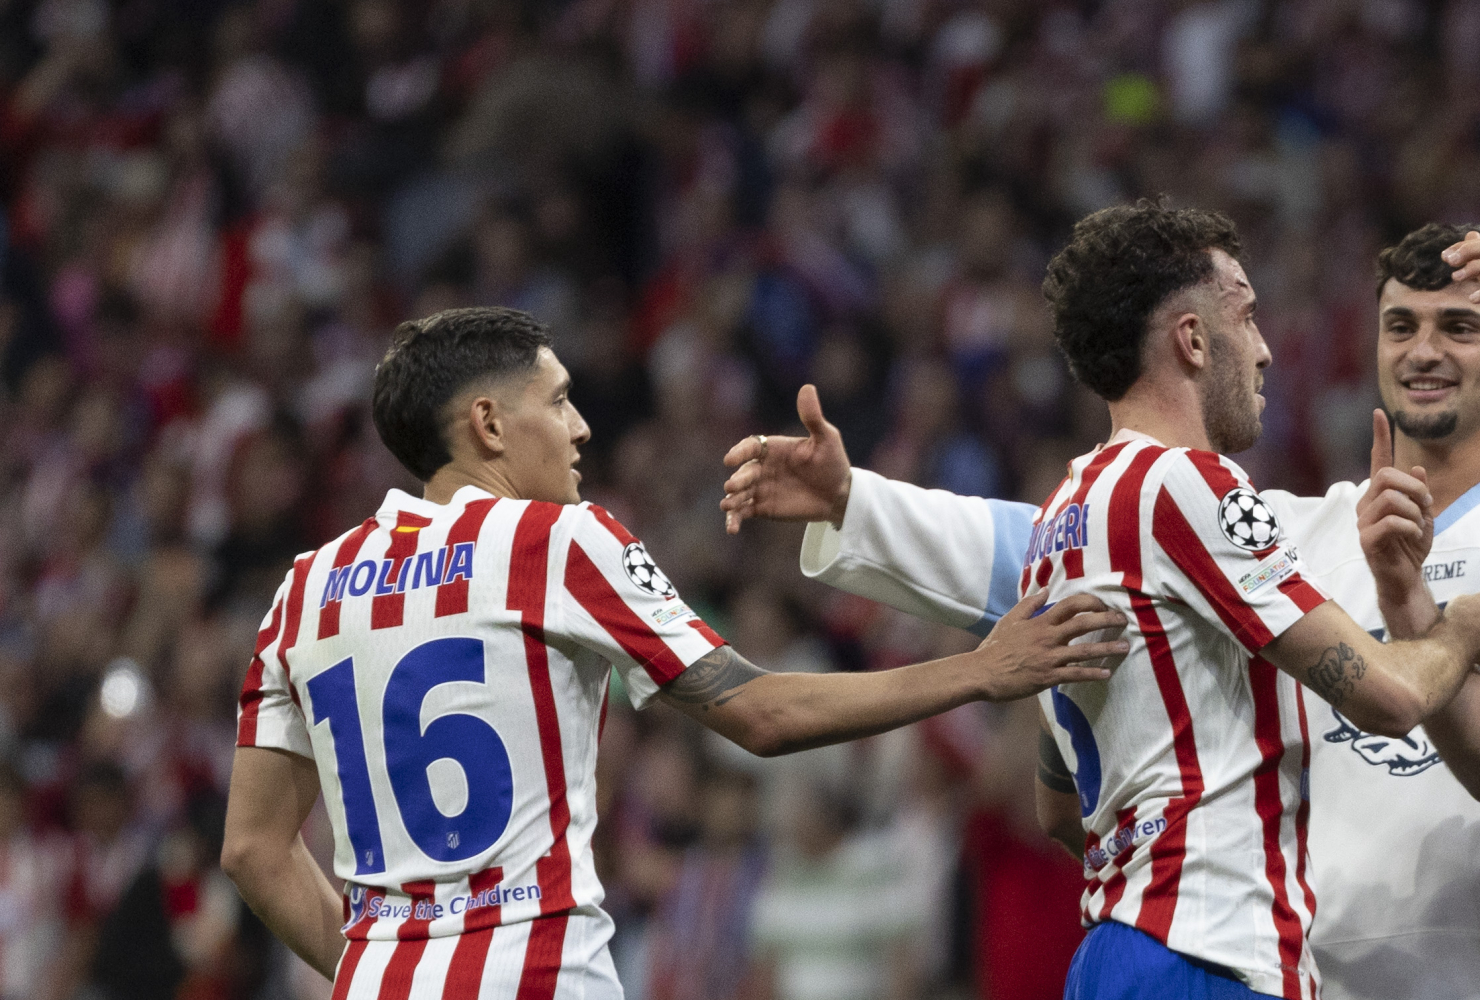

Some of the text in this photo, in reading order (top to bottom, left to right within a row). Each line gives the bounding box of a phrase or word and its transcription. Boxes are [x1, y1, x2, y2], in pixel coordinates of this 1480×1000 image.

[1022, 503, 1090, 569] UGGERI
[319, 541, 475, 608] MOLINA
[1422, 560, 1466, 581] REME
[306, 637, 514, 876] 16
[367, 883, 541, 920] Save the Children
